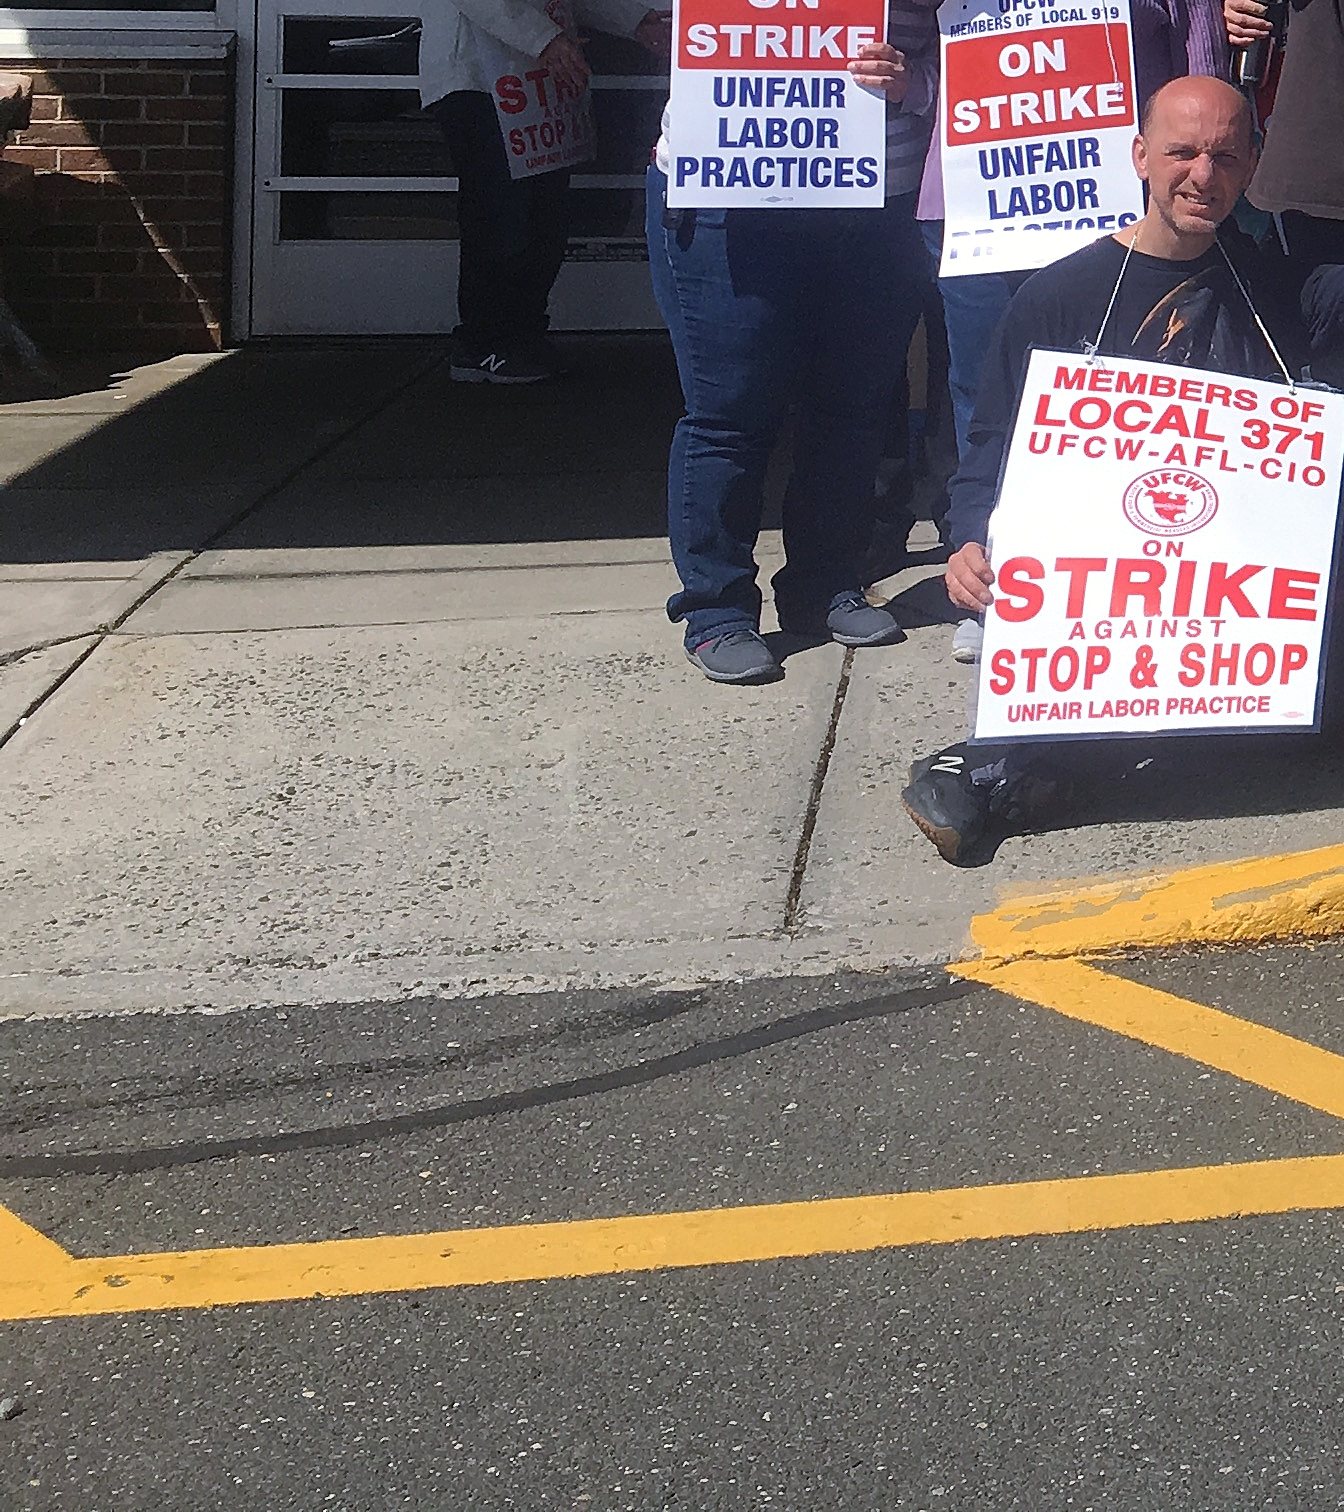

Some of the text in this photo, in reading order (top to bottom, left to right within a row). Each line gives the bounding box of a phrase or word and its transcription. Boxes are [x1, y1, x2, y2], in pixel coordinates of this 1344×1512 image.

[950, 6, 1120, 38] MEMBERS OF LOCAL 919
[685, 24, 876, 59] STRIKE
[998, 38, 1067, 79] ON
[713, 76, 846, 109] UNFAIR
[952, 82, 1126, 134] STRIKE
[509, 119, 566, 156] STOP
[718, 117, 839, 149] LABOR
[675, 156, 878, 188] PRACTICES
[978, 137, 1101, 180] UNFAIR
[988, 178, 1100, 221] LABOR
[1053, 366, 1325, 423] MEMBERS OF
[1033, 394, 1326, 462] LOCAL 371
[1028, 431, 1326, 488] UFCW-AFL-CIO
[1142, 472, 1206, 491] UFCW
[1142, 540, 1184, 558] ON
[994, 556, 1321, 623] STRIKE
[1068, 619, 1227, 641] AGAINST
[989, 642, 1309, 696] STOP & SHOP
[1007, 695, 1271, 723] UNFAIR LABOR PRACTICE
